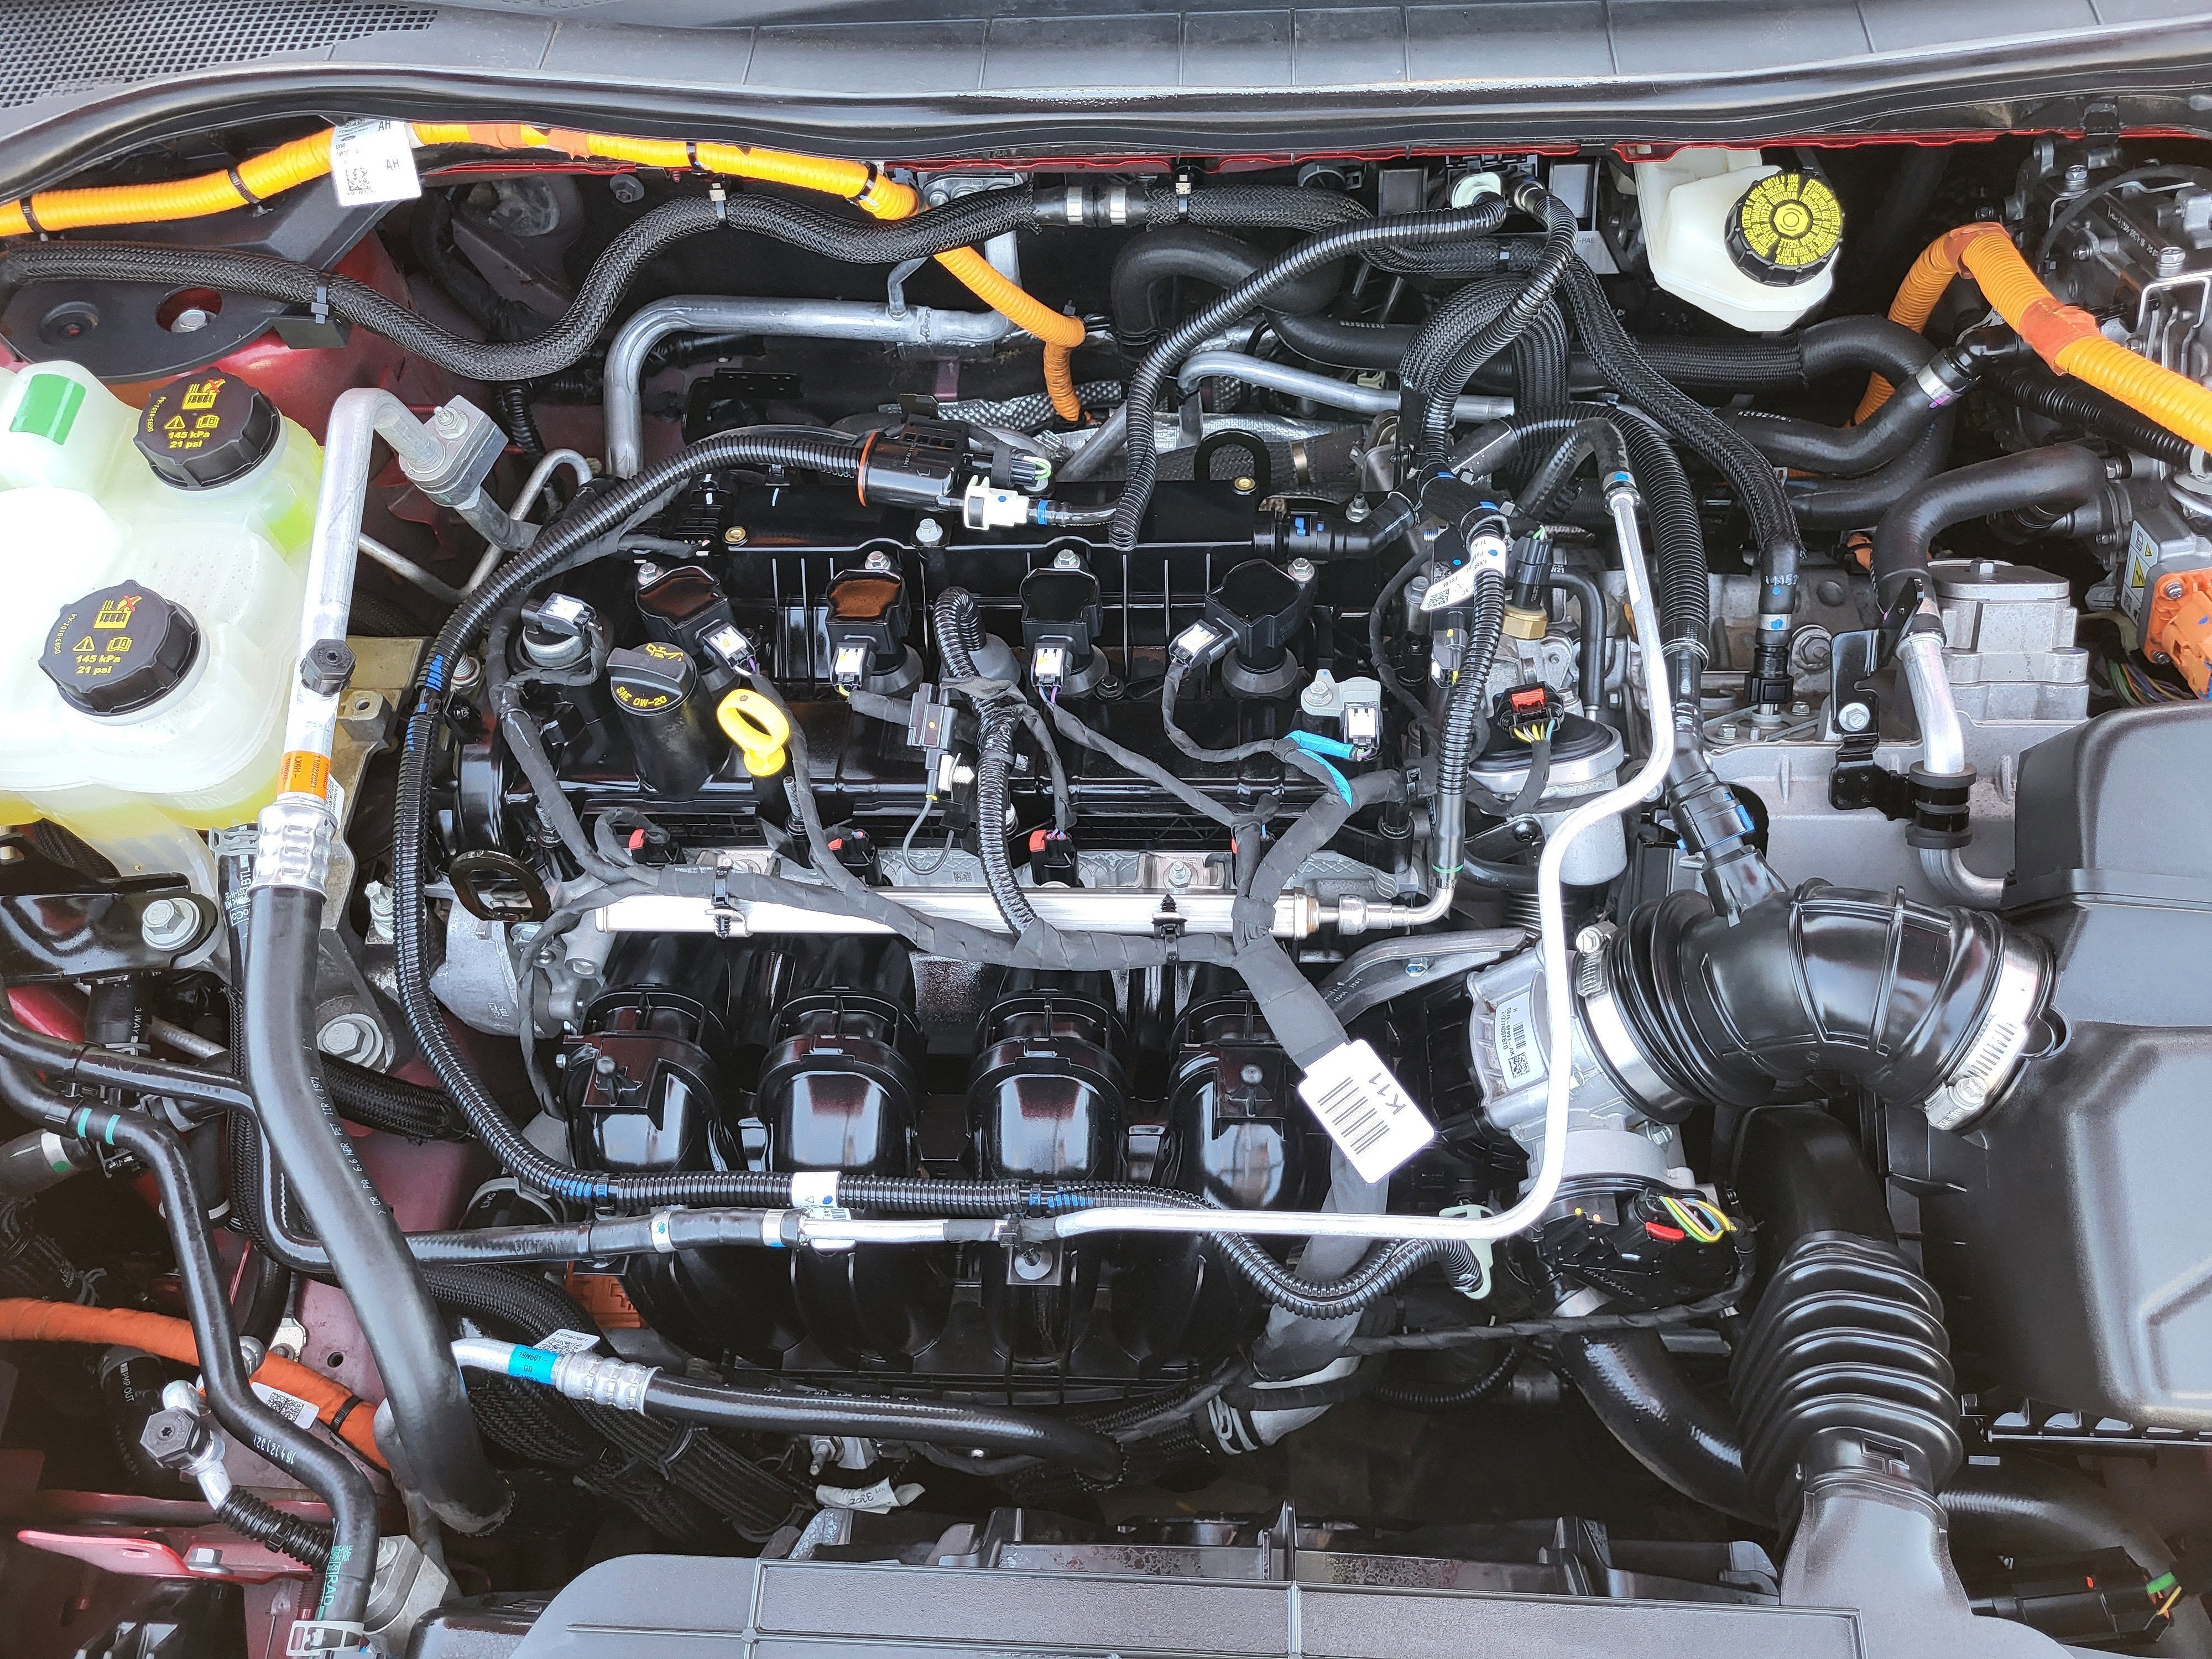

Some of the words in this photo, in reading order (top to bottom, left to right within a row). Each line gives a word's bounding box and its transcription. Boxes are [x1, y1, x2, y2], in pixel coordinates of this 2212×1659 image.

[386, 158, 400, 171] AH
[1762, 176, 1780, 189] FLUID
[1781, 174, 1785, 183] 4
[1787, 175, 1798, 183] DOT
[1748, 185, 1765, 201] FROM
[1763, 184, 1785, 199] BEFORE
[1787, 183, 1798, 191] CAP
[1806, 179, 1833, 201] ATTENTION
[1769, 191, 1797, 205] WARNING
[1751, 196, 1767, 222] REMOVING
[1759, 204, 1773, 222] CLEAN
[1799, 194, 1822, 219] PROVENANT
[1827, 200, 1840, 226] NETTOYER
[1742, 206, 1752, 228] SEALED
[1822, 210, 1832, 220] QUE
[1752, 223, 1763, 236] USE
[1760, 223, 1778, 243] FILLER
[1830, 226, 1840, 234] LE
[1744, 229, 1768, 257] CONTAINER
[1757, 234, 1773, 249] ONLY
[1800, 232, 1816, 246] BIDON
[1813, 228, 1829, 246] LIQUIDE
[1793, 246, 1809, 257] FREIN
[1807, 242, 1817, 252] DE
[1816, 233, 1837, 256] BOUCHON
[1781, 248, 1792, 257] DOT
[1799, 251, 1817, 265] AVANT
[147, 397, 168, 433] DG93-8101-AA
[185, 440, 204, 450] psi
[54, 613, 79, 655] DG93-8101-AA
[76, 655, 98, 663] 145
[98, 655, 122, 663] kPa
[76, 666, 91, 674] 21
[93, 666, 113, 676] psi
[616, 686, 633, 702] SAE
[633, 696, 667, 707] 0W-20
[310, 755, 321, 789] 11/02/2021
[240, 867, 252, 886] BTL
[133, 1014, 142, 1034] WAY
[310, 1076, 325, 1092] 1971
[1368, 1072, 1407, 1114] K11
[320, 1102, 334, 1116] IIR
[330, 1123, 343, 1135] PET
[340, 1142, 354, 1156] NBR
[361, 1179, 372, 1190] PA
[369, 1196, 381, 1206] CR
[121, 1372, 132, 1386] PMP
[124, 1386, 135, 1402] OUT
[324, 1574, 338, 1606] RAD
